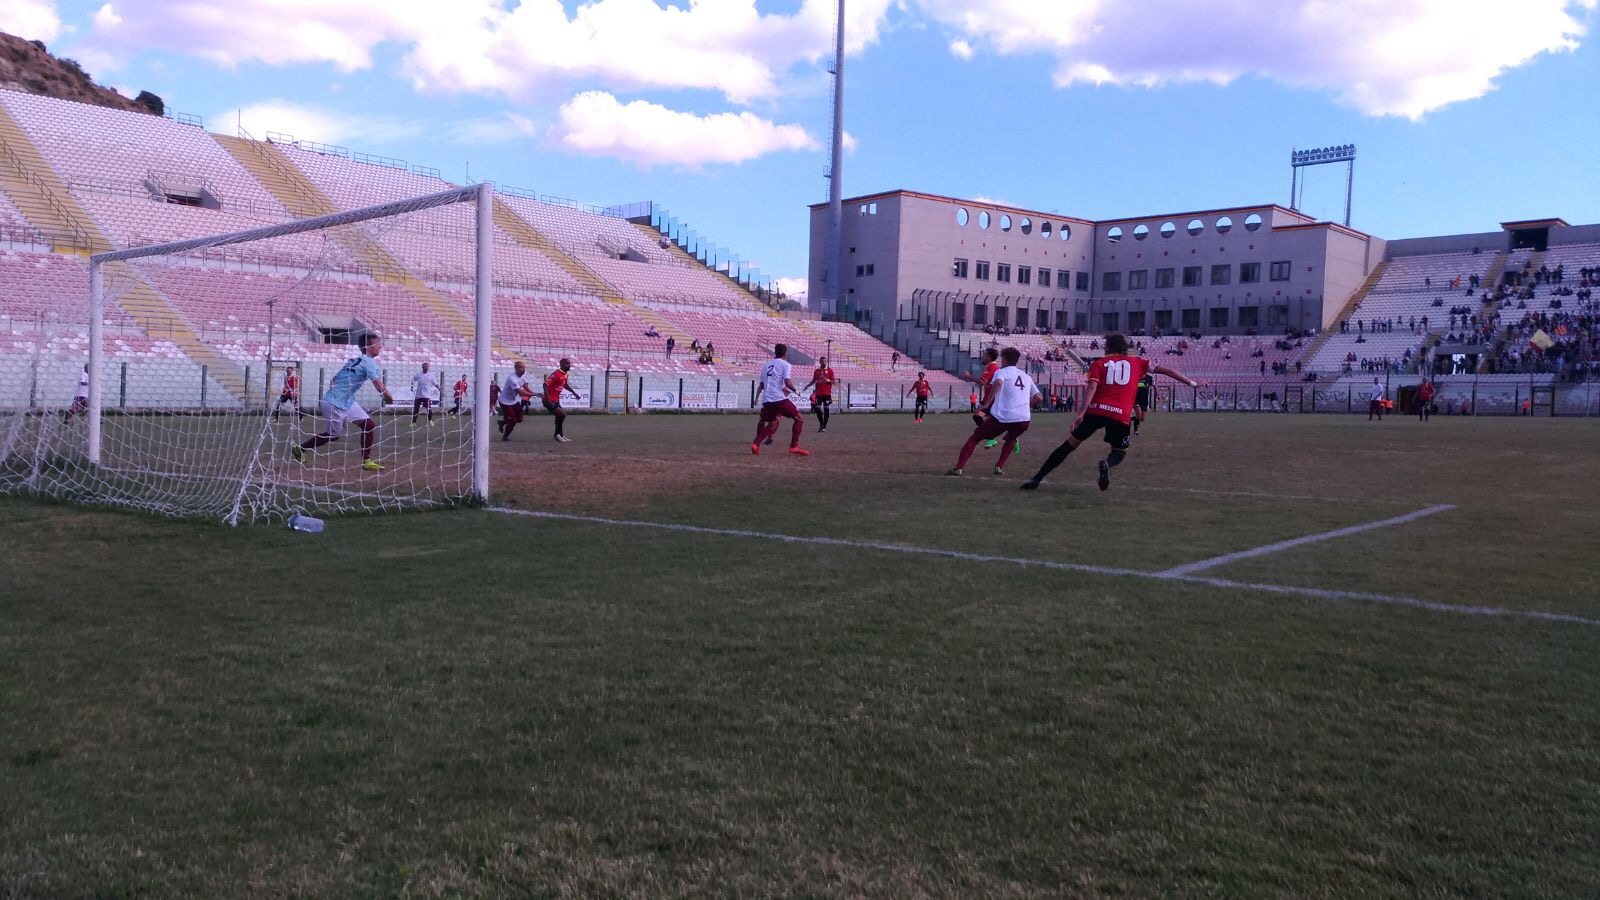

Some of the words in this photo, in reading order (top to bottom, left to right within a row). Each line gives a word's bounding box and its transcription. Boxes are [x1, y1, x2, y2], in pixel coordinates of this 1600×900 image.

[767, 365, 775, 376] 2
[1104, 360, 1131, 385] 10
[1015, 375, 1025, 390] 4
[1099, 403, 1123, 414] MESSINA
